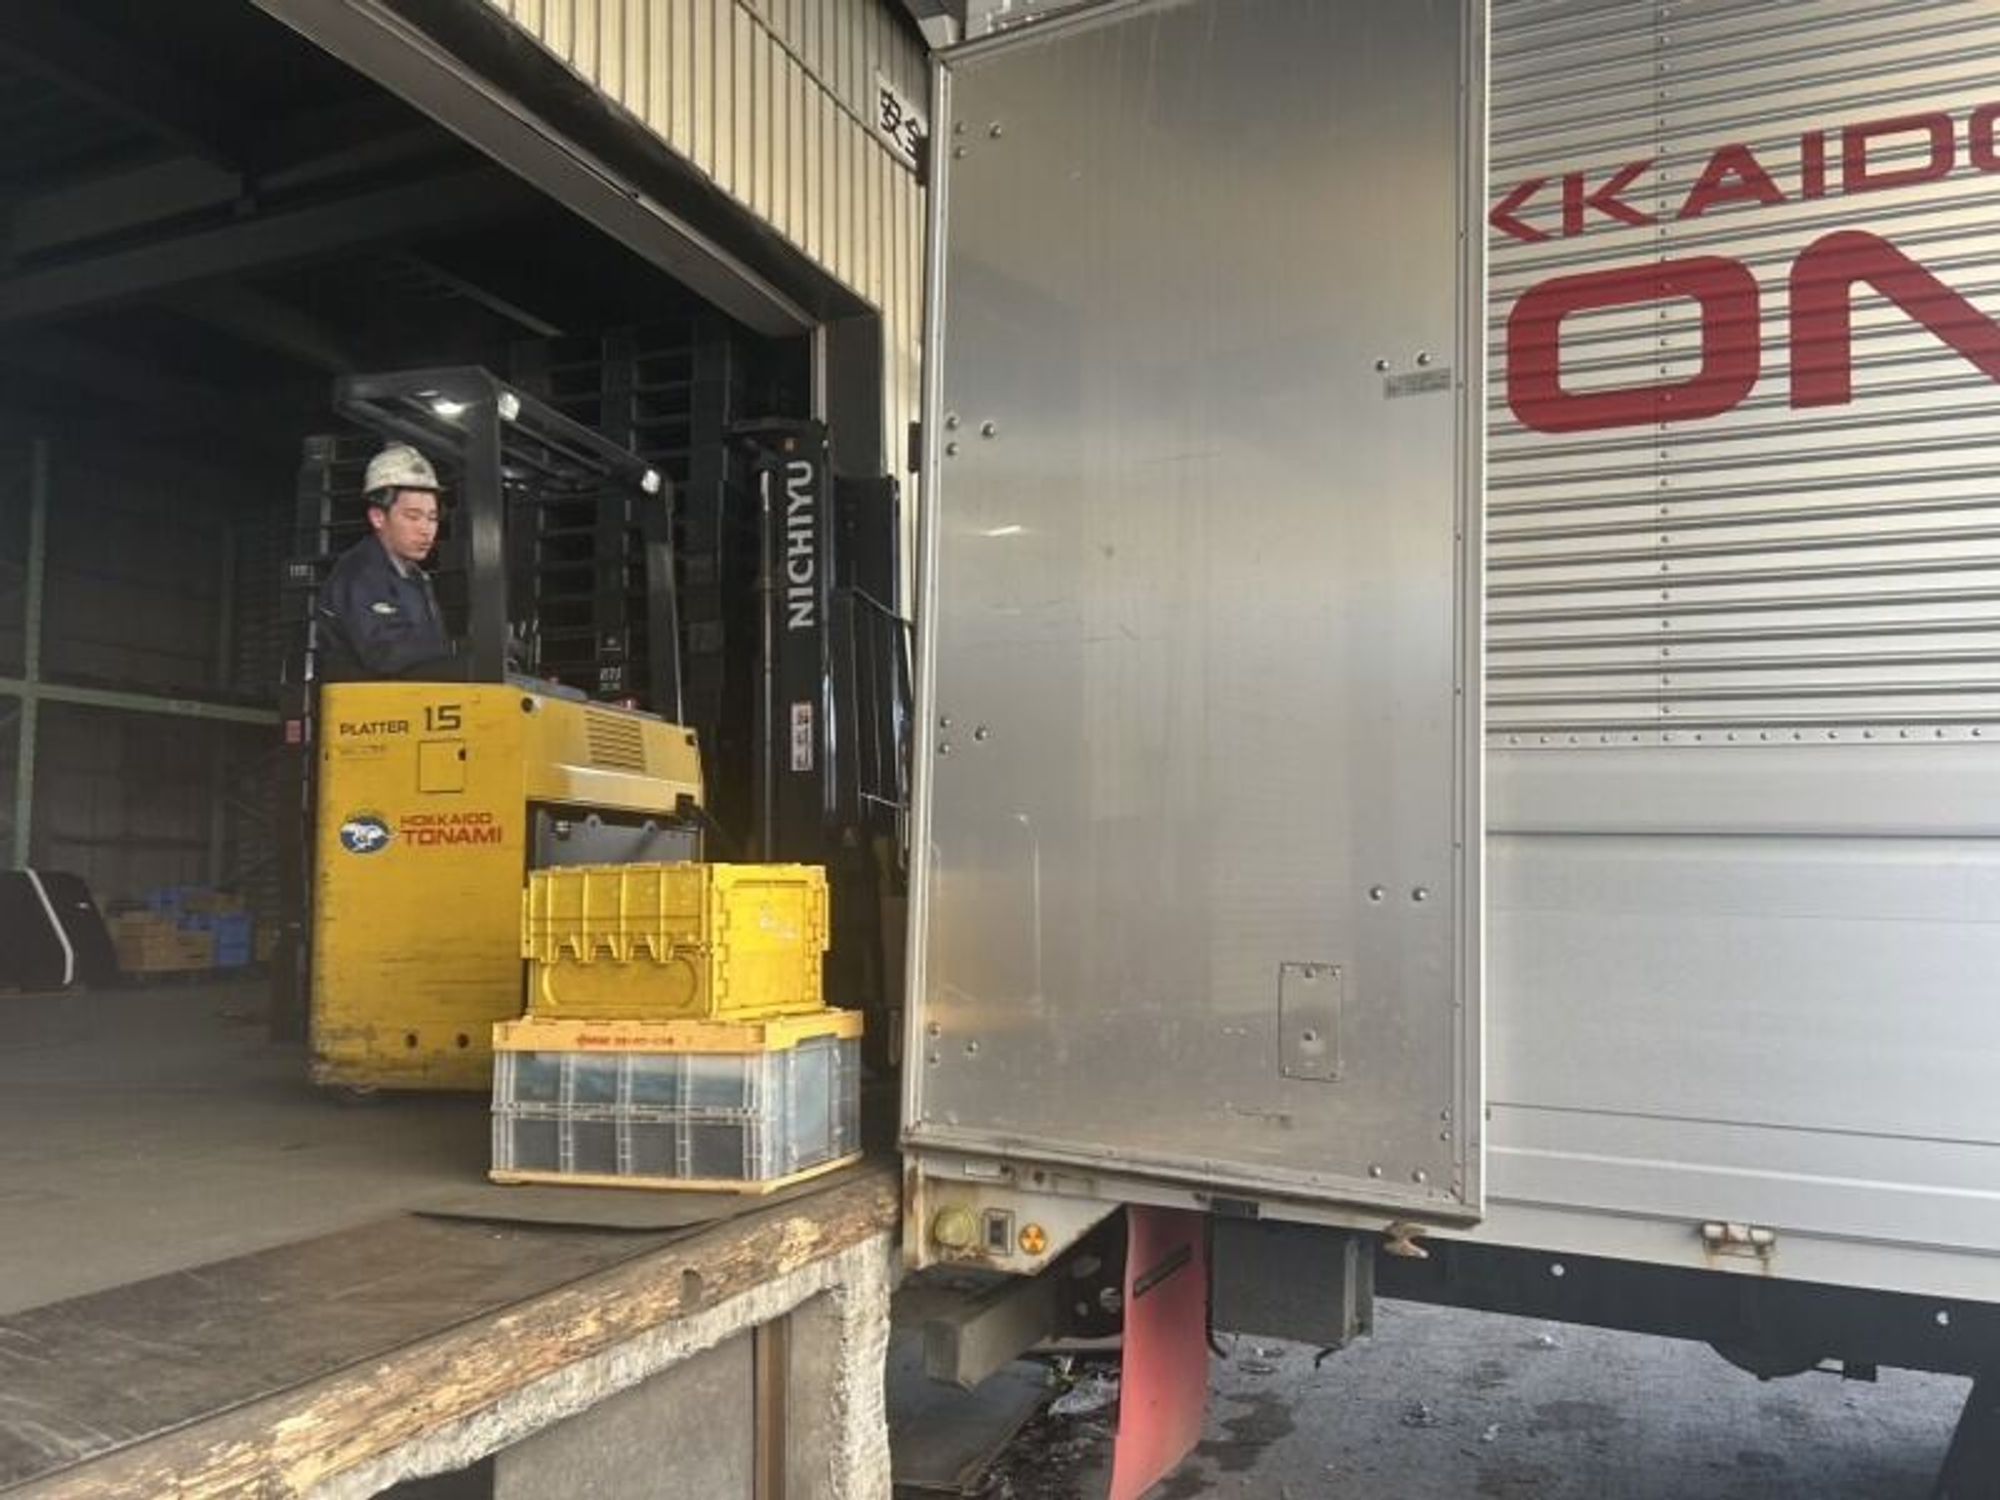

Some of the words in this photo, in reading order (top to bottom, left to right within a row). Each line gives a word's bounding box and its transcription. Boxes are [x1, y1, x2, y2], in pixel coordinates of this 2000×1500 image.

[787, 459, 814, 630] NICHIYU
[339, 719, 409, 736] PLATTER
[423, 704, 462, 732] 15
[400, 812, 493, 827] HOKKAIDO
[400, 826, 502, 847] TONAMI
